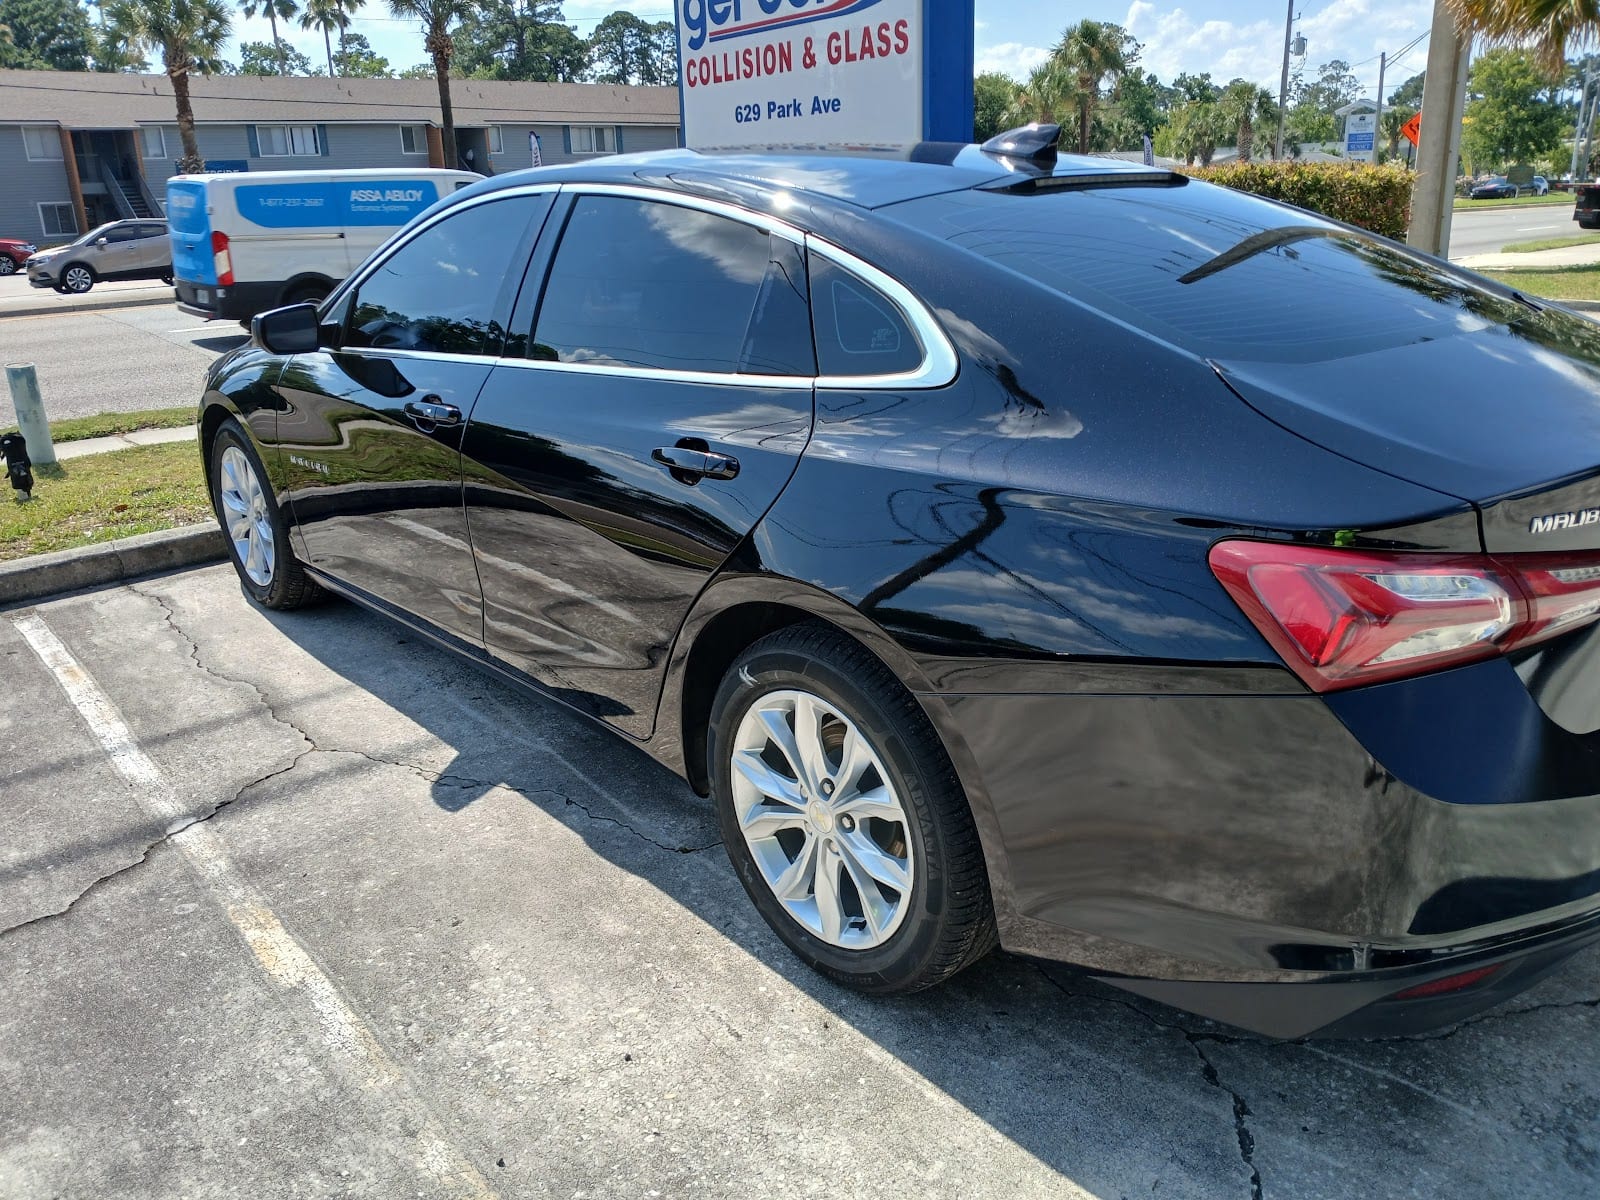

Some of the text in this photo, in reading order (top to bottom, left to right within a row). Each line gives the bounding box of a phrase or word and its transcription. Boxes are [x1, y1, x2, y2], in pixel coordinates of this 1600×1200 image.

[686, 19, 909, 88] COLLISION & GLASS
[735, 95, 841, 123] 629 Park Ave
[350, 190, 423, 202] ASSA ABLOY
[1530, 509, 1600, 534] MALIB
